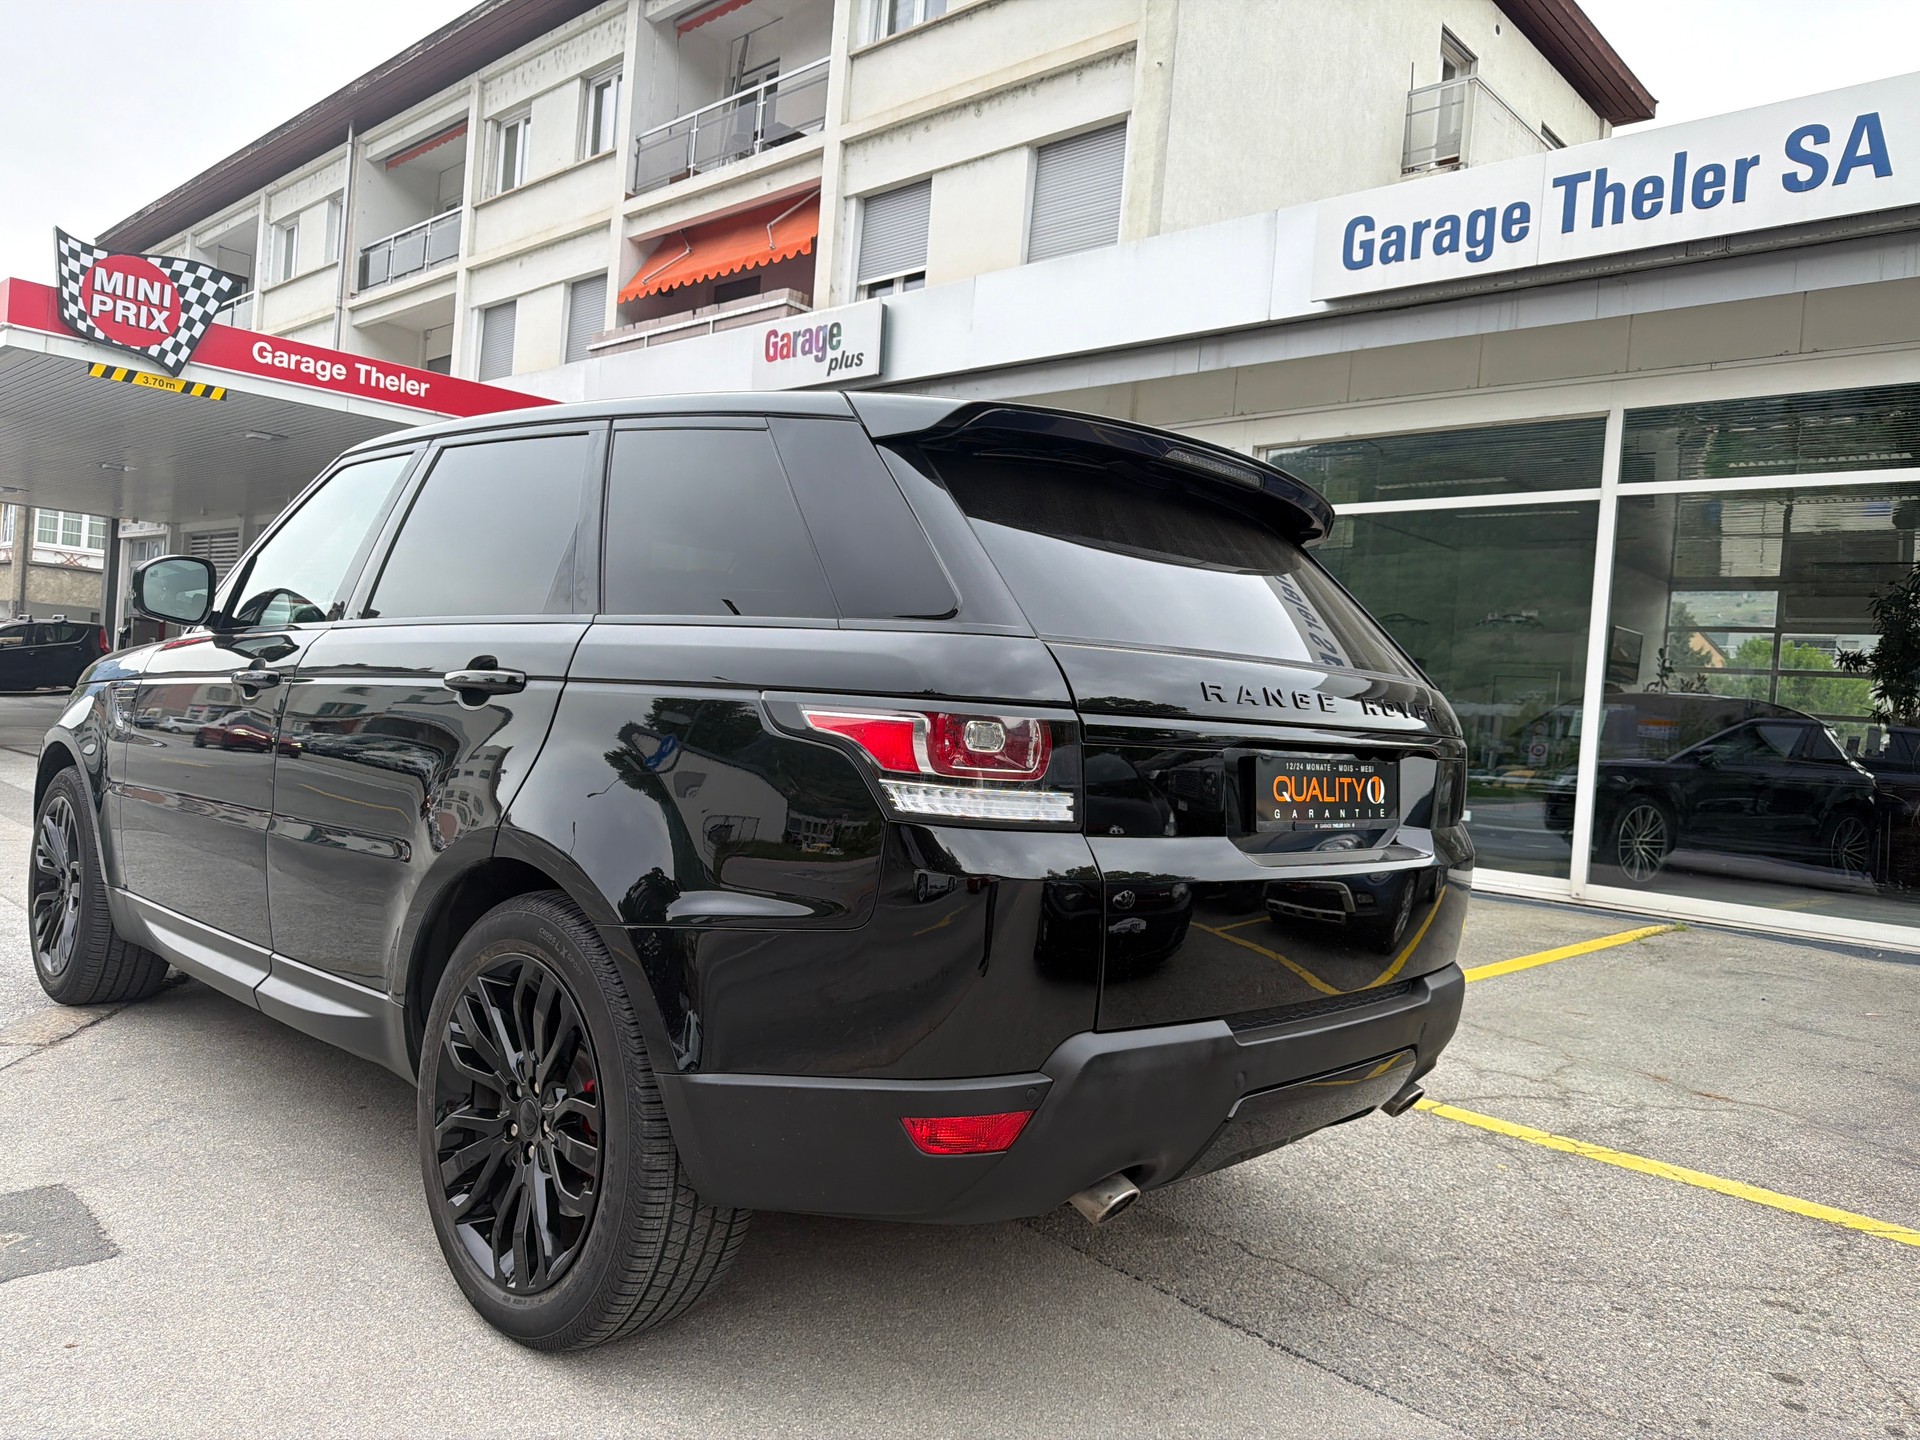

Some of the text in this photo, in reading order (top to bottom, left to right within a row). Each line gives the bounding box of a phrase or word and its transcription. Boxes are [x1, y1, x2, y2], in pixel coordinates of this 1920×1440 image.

[1343, 112, 1893, 271] Garage Theler SA
[93, 266, 172, 308] MINI
[92, 293, 171, 334] PRIX
[765, 322, 842, 363] Garage
[252, 341, 430, 398] Garage Theler
[826, 350, 865, 377] plus
[1200, 681, 1440, 723] RANGE ROVER
[1286, 762, 1304, 771] 12/24
[1306, 763, 1331, 772] MONATE
[1338, 764, 1354, 772] MOIS
[1273, 775, 1366, 802] QUALITY
[1274, 808, 1385, 819] GARANTIE
